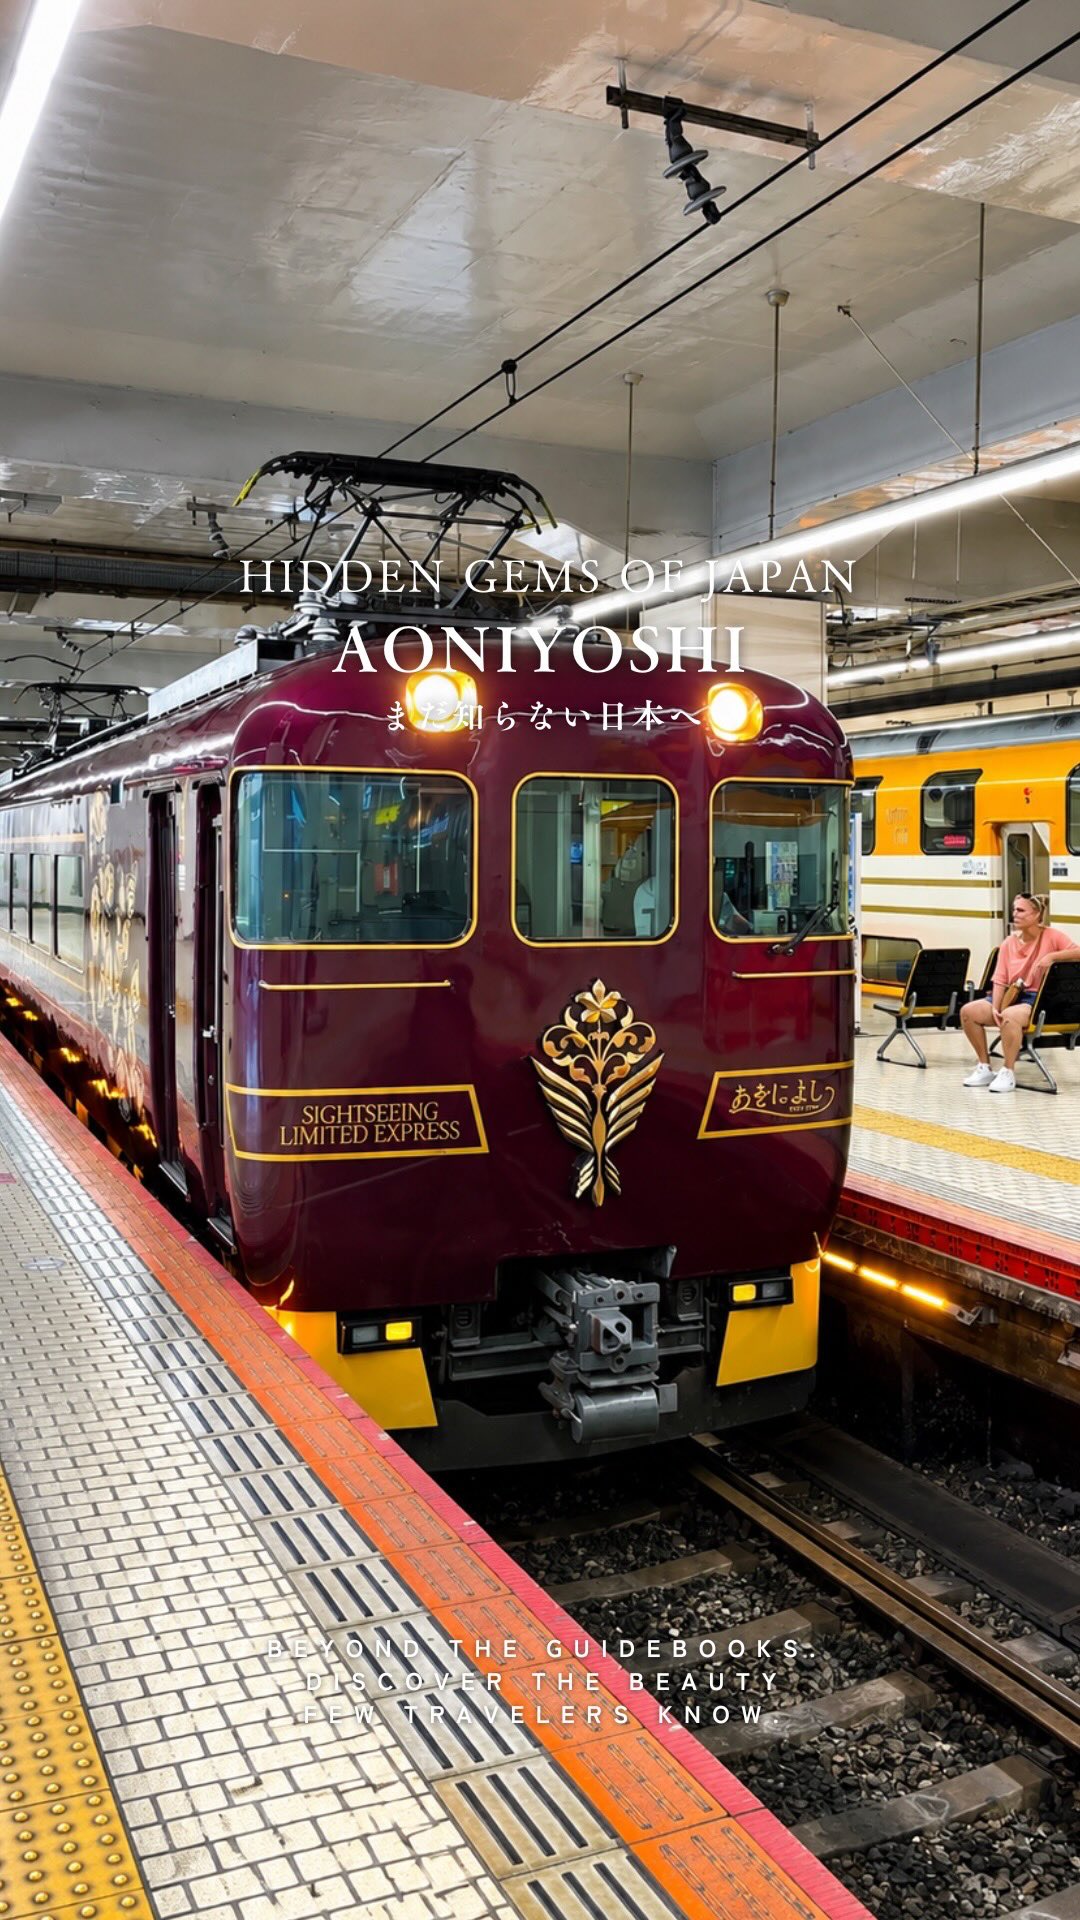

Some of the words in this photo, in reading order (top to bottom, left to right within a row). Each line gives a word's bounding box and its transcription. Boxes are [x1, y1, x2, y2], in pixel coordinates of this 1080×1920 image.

[301, 1102, 439, 1124] SIGHTSEEING
[280, 1125, 369, 1146] LIMITED
[374, 1120, 461, 1144] EXPRESS
